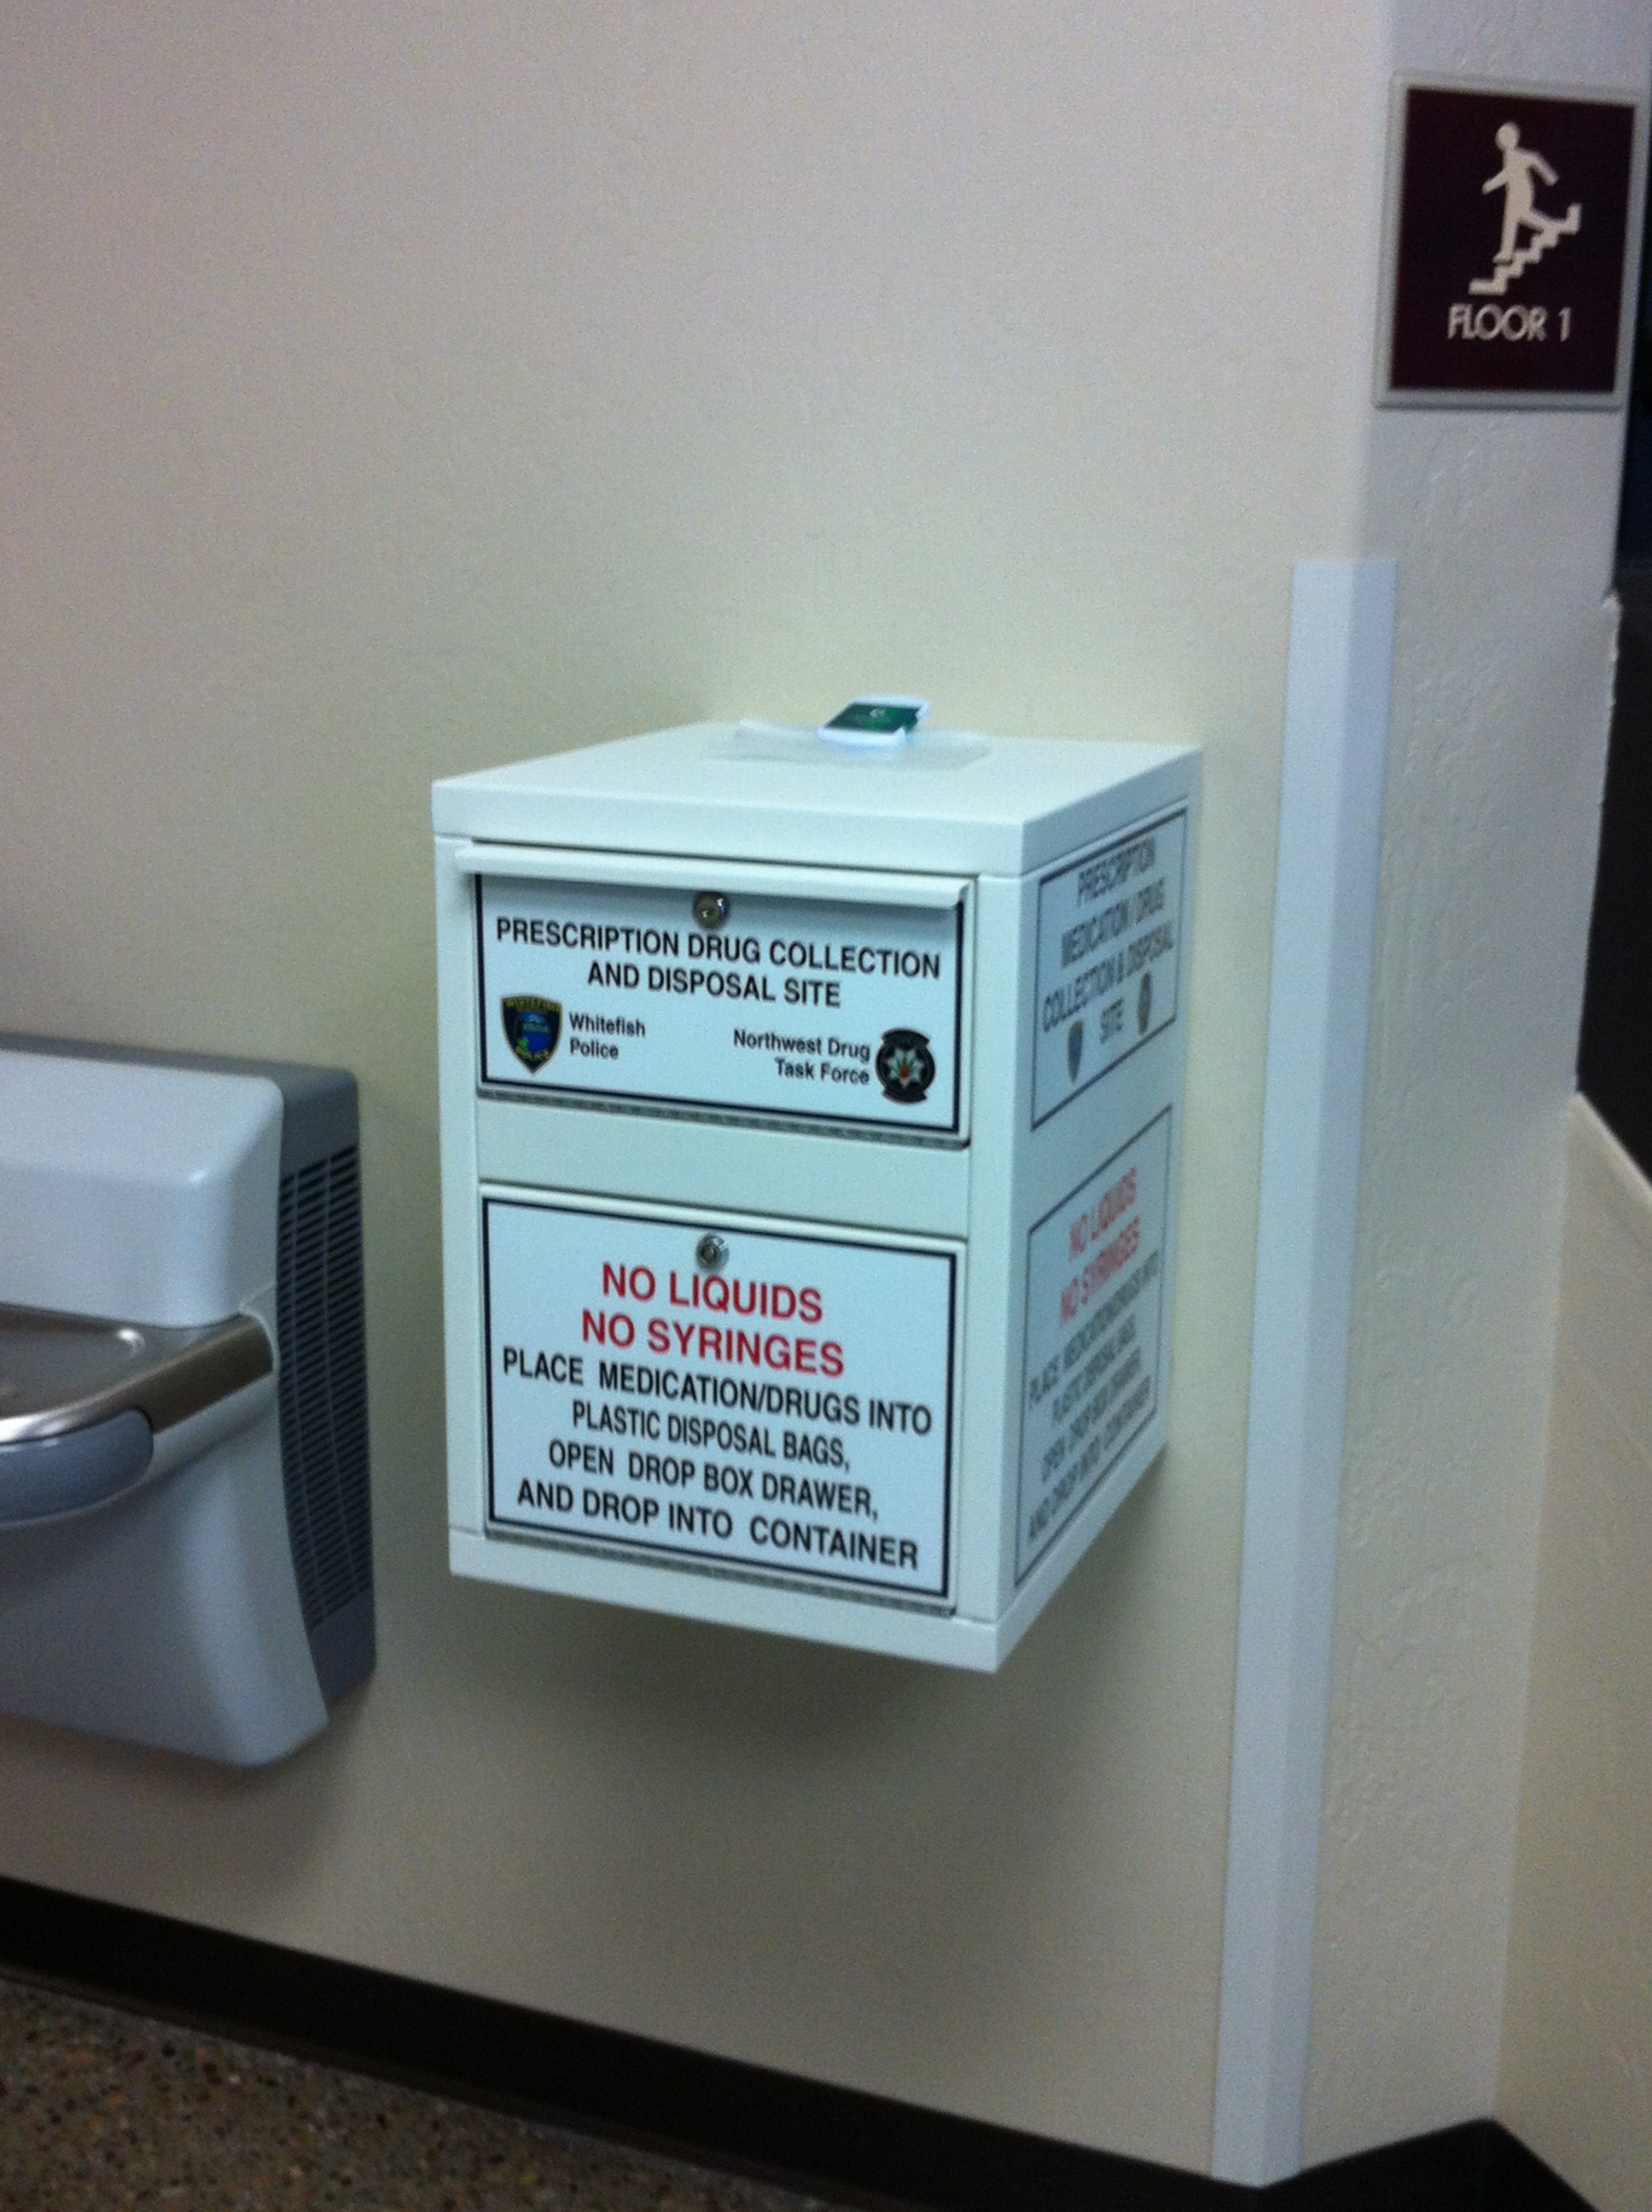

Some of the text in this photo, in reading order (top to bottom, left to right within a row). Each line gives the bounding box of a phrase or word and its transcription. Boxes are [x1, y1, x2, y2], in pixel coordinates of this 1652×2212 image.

[1447, 303, 1572, 342] FLOOR 1
[497, 917, 941, 980] PRESCRIPTION DRUG COLLECTION
[587, 961, 841, 1008] AND DISPOSAL SITE
[568, 1011, 646, 1037] Whitefish
[569, 1038, 620, 1060] Police
[733, 1028, 870, 1062] Northwest Drug
[775, 1057, 870, 1086] Task Force
[602, 1262, 823, 1324] NO LIQUIDS
[582, 1309, 845, 1378] NO SYRINGES
[503, 1346, 932, 1435] PLACE MEDICATION/DRUGS INTO
[572, 1399, 851, 1471] PLASTIC DISPOSAL BAGS,
[549, 1439, 878, 1521] OPEN DROP BOX DRAWER,
[517, 1478, 919, 1570] AND DROP INTO CONTAINER
